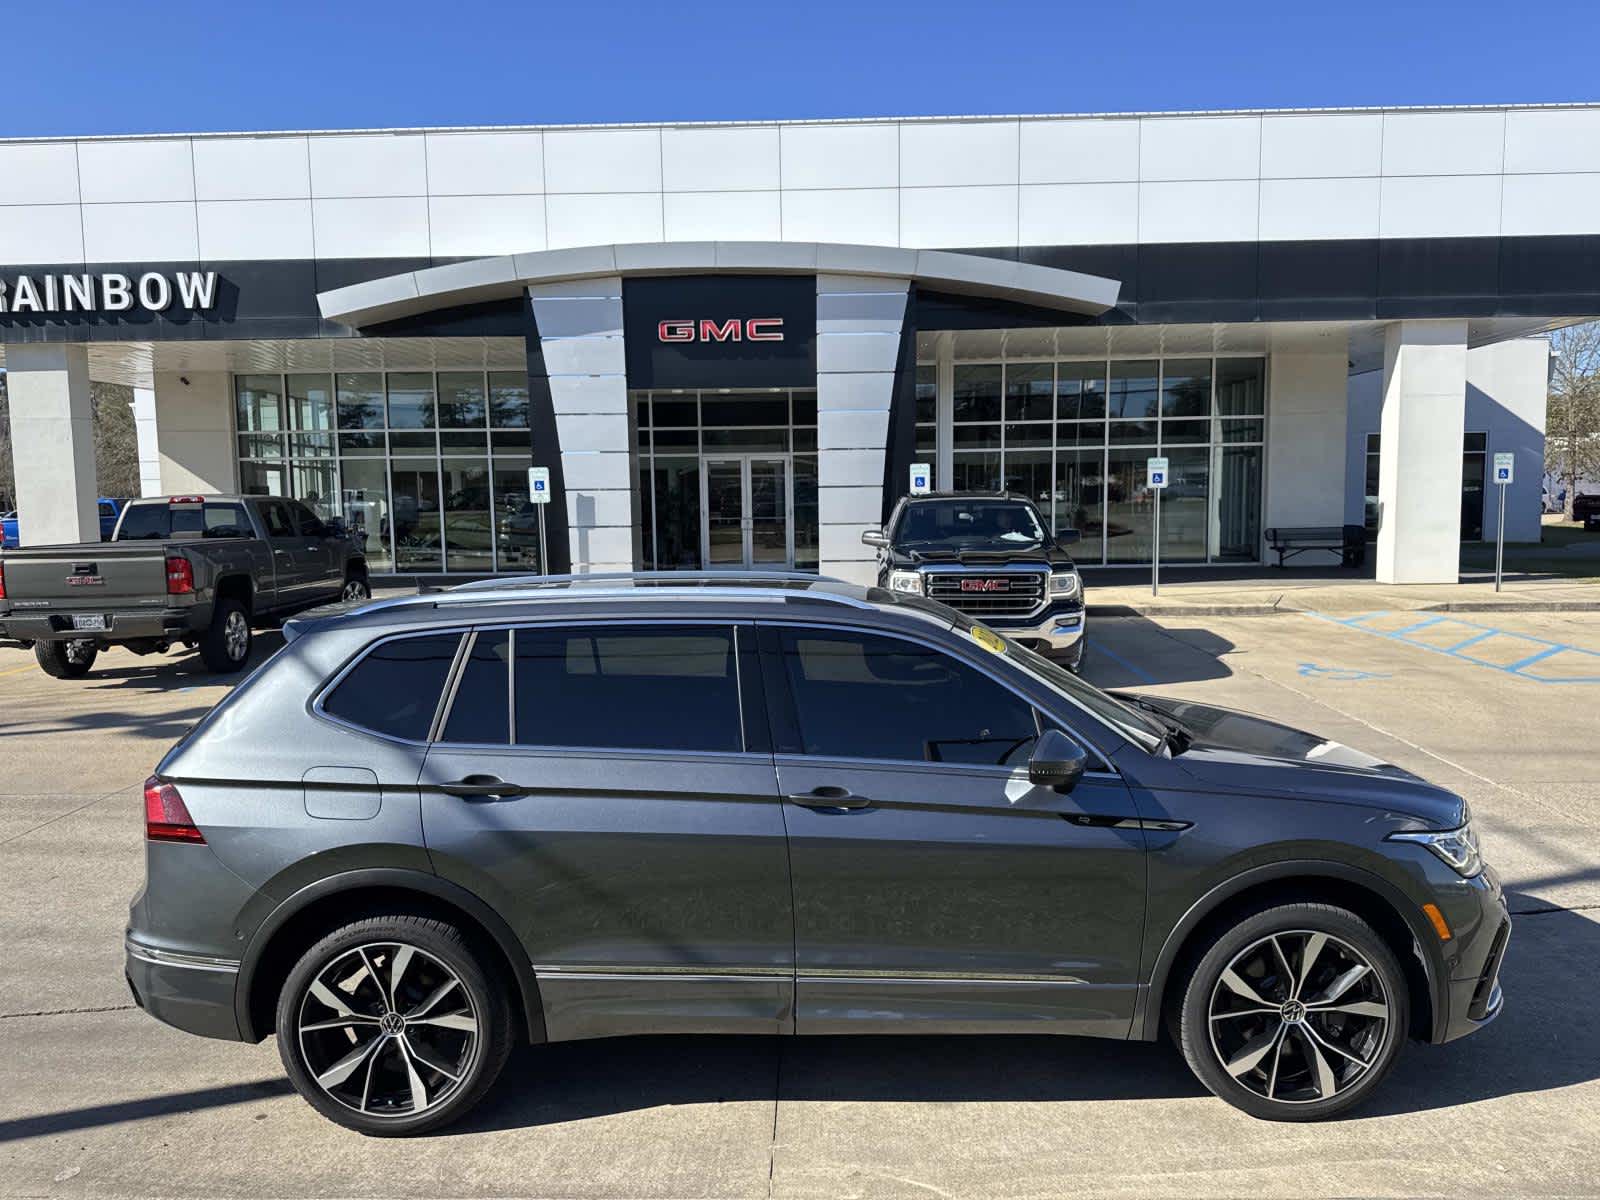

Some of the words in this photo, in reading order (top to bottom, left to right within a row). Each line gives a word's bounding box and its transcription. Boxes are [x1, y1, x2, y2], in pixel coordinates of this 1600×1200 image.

[0, 271, 217, 313] AINBOW
[658, 318, 784, 342] GMC
[961, 579, 1009, 591] GMC
